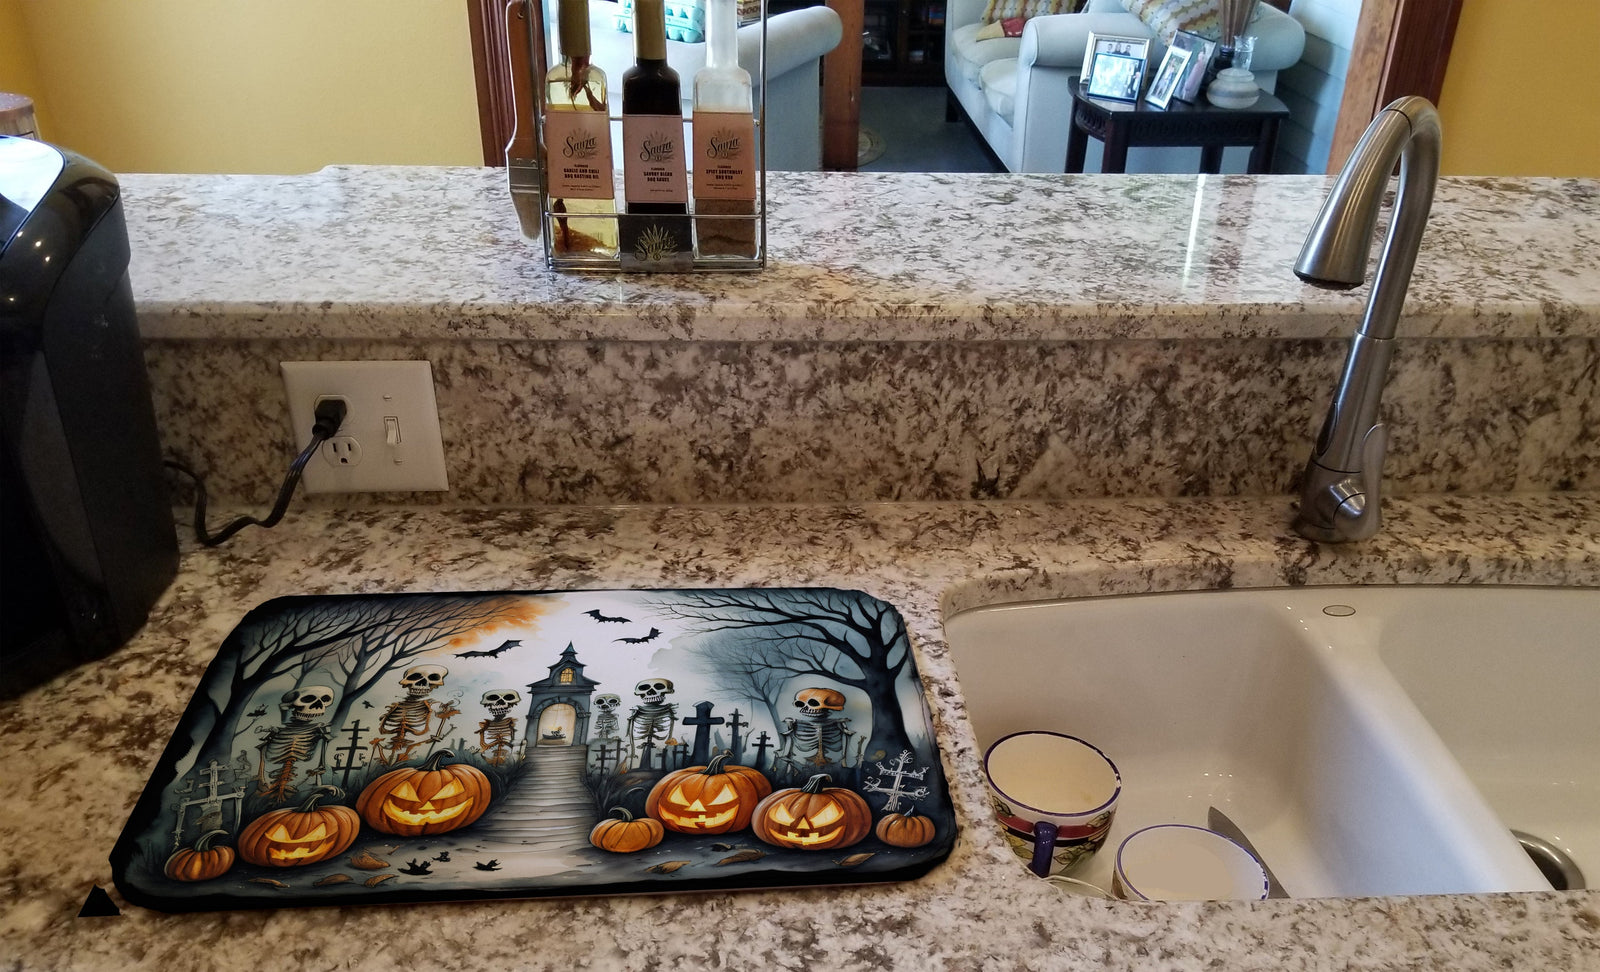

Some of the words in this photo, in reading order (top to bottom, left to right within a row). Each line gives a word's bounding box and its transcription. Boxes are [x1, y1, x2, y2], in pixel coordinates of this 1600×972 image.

[562, 135, 597, 158] Sauza
[639, 139, 674, 161] Sauza
[706, 136, 741, 159] Sauza
